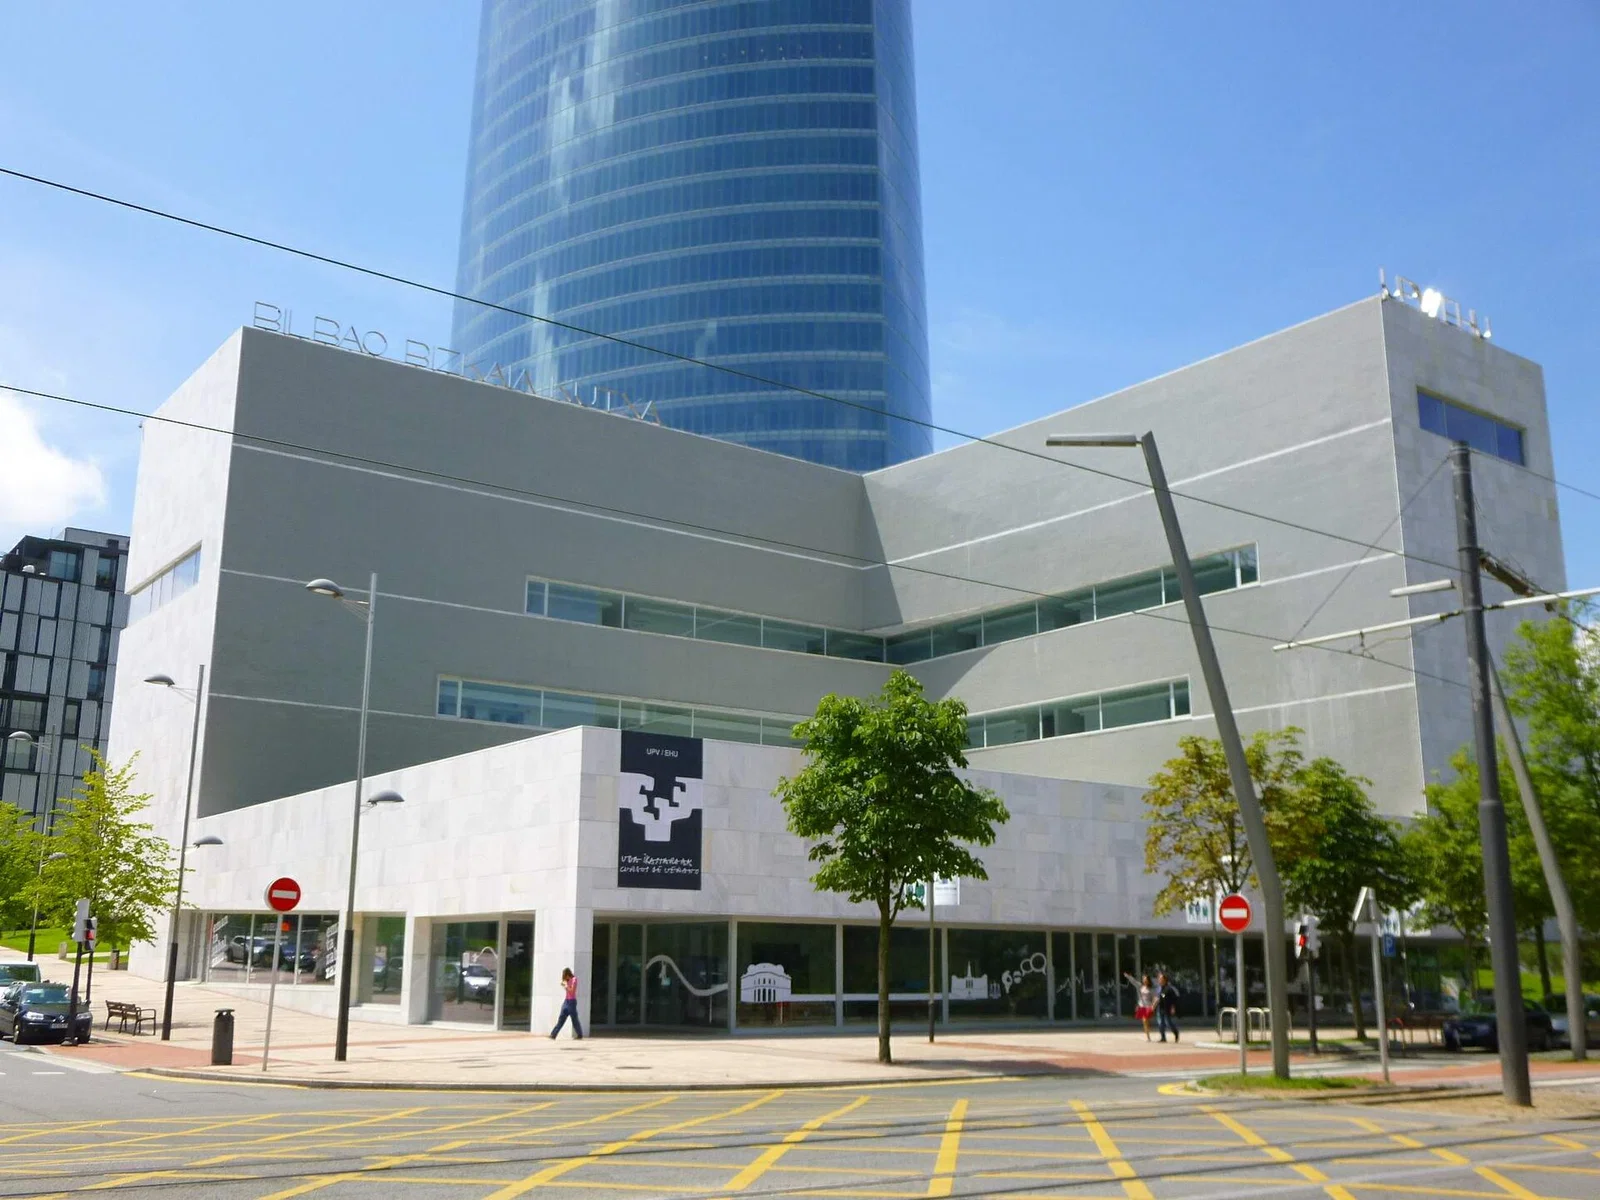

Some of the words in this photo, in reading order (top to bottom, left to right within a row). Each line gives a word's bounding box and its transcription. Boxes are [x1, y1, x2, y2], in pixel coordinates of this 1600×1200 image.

[253, 300, 389, 357] BILBAO
[646, 747, 660, 756] UPV
[664, 749, 679, 758] EHU
